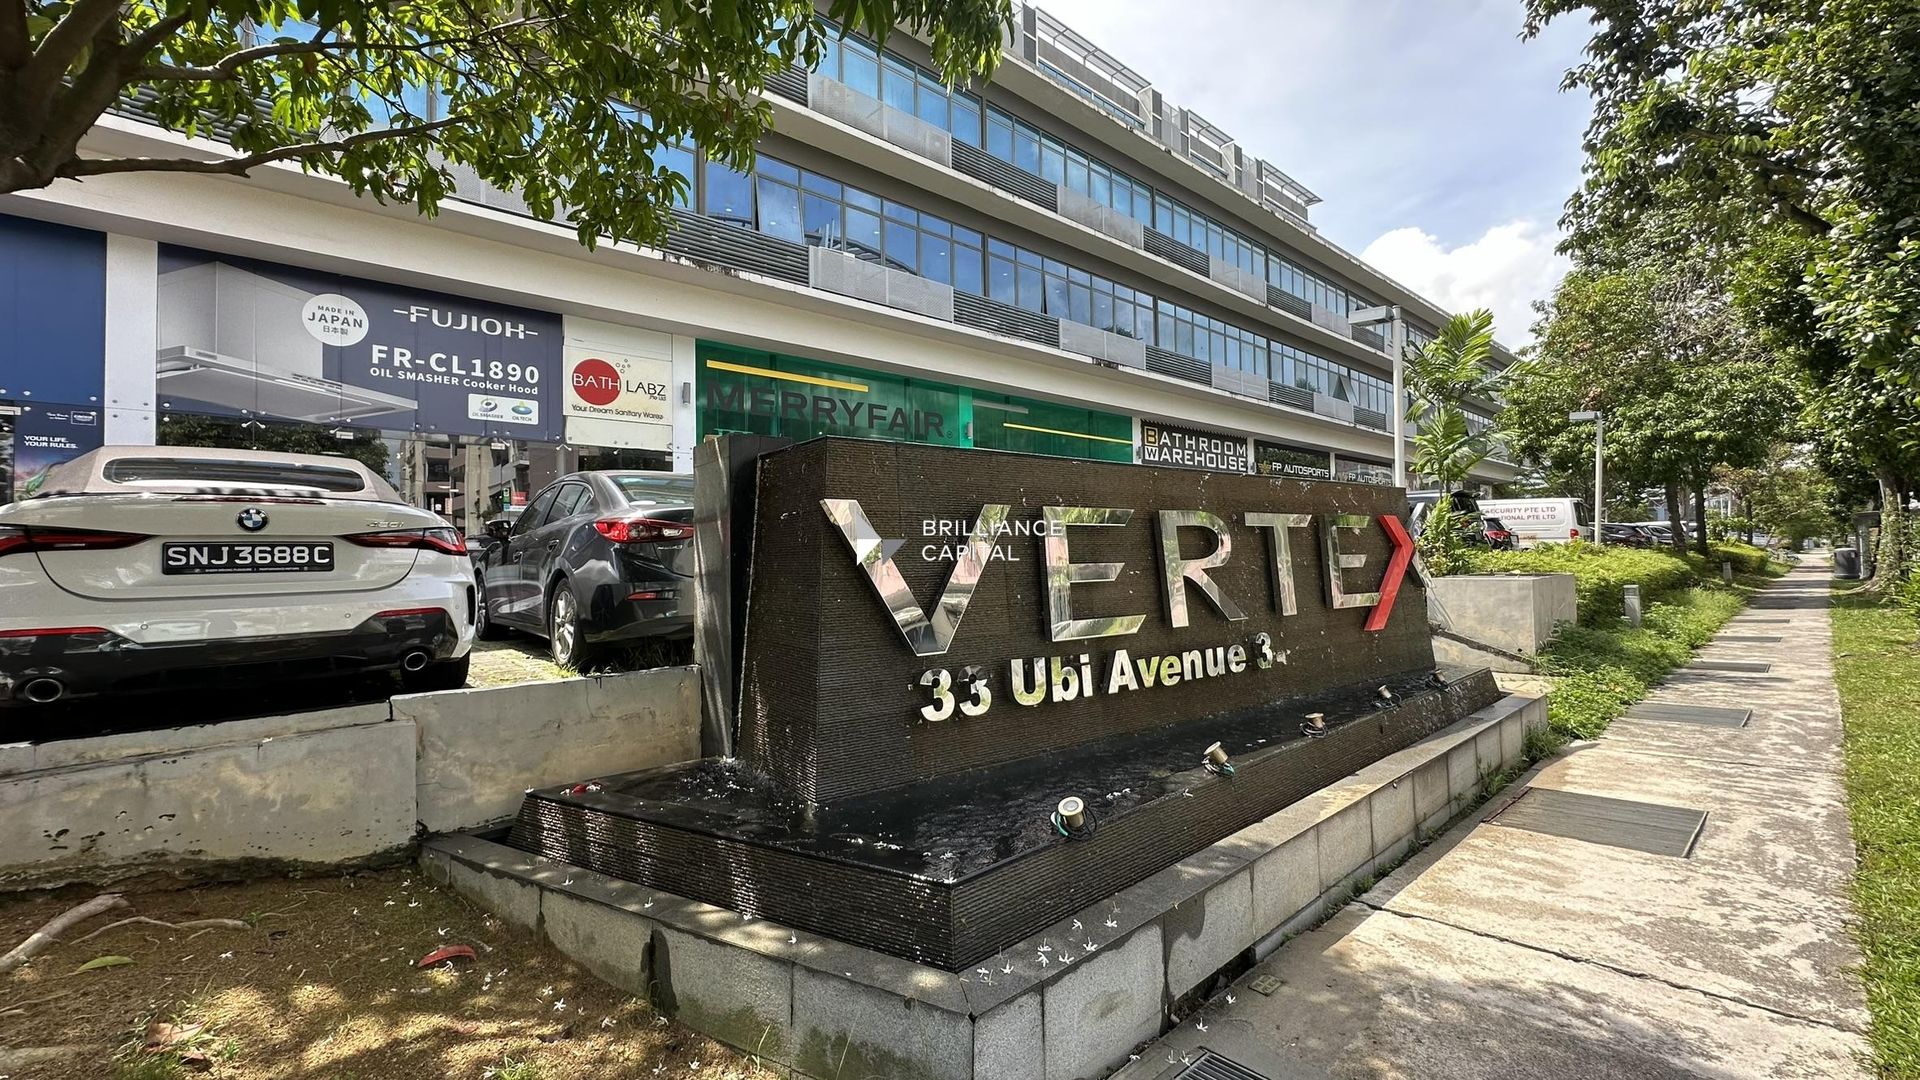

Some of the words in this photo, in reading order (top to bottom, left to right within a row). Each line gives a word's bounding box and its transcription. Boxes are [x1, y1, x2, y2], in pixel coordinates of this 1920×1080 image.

[307, 311, 363, 329] JAPAN
[317, 305, 342, 314] MADE
[371, 344, 540, 384] FR-CL1890
[369, 367, 394, 379] OIL
[397, 369, 460, 387] SMASHER
[462, 377, 506, 392] Cooker
[508, 383, 539, 396] Hood
[573, 372, 621, 392] BATH
[626, 379, 667, 397] LABZ
[571, 403, 588, 413] Your
[589, 406, 614, 415] Dream
[614, 408, 642, 419] Sanitary
[706, 377, 945, 439] MERRYFAIR
[24, 440, 48, 448] YOUR
[1144, 426, 1247, 457] BATHROOM
[1144, 445, 1247, 471] WAREHOUSE
[1272, 462, 1282, 471] FP
[1283, 465, 1330, 478] AUTOSPORTS
[167, 546, 331, 567] SNJ3688C
[819, 498, 1432, 656] VERTEX
[918, 664, 993, 723] 33
[1010, 652, 1094, 707] Ubi
[1106, 643, 1247, 696] Avenue
[1255, 631, 1275, 670] 3
